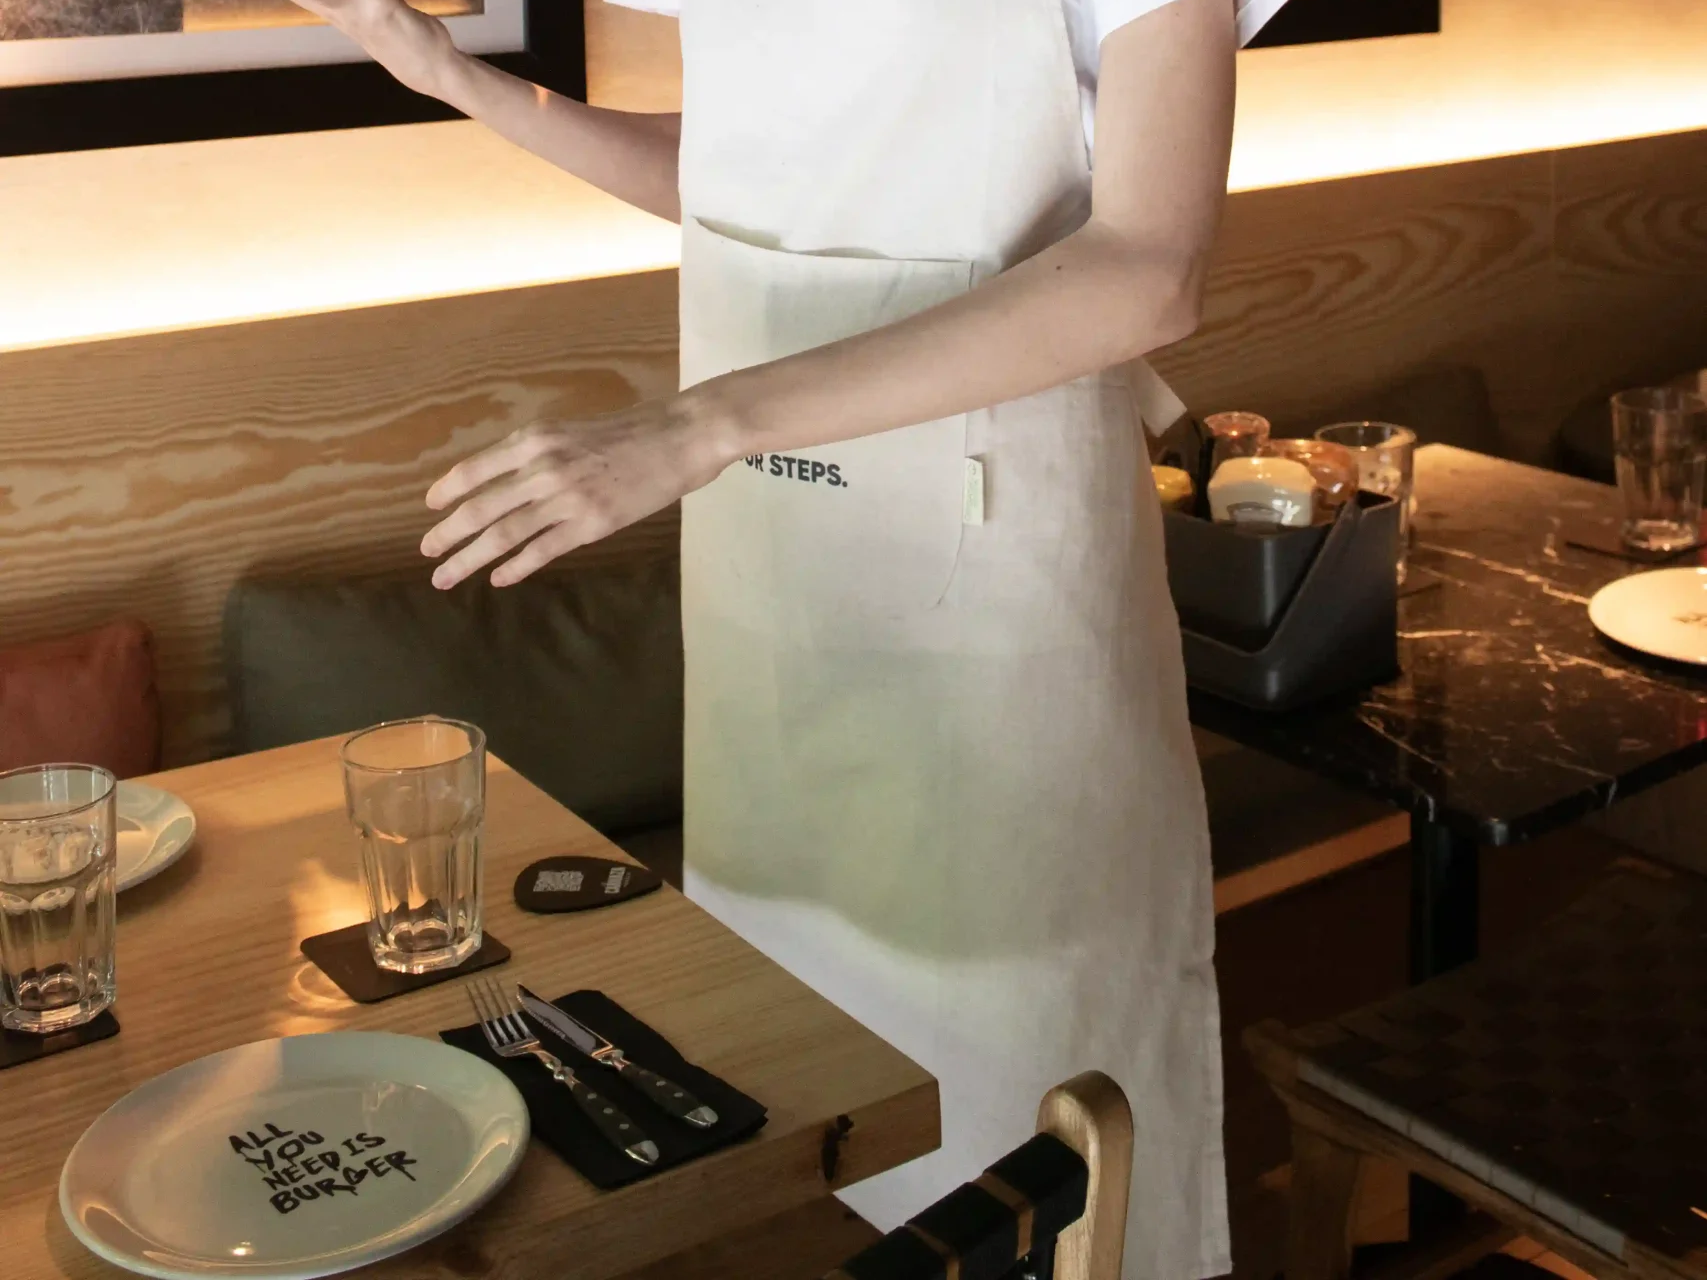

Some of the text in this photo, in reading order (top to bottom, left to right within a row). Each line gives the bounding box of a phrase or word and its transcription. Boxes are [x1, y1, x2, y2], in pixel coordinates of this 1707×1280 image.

[741, 453, 848, 488] UR STEPS.
[228, 1122, 294, 1156] ALL
[245, 1130, 325, 1171] YOU
[262, 1132, 386, 1191] NEED IS
[269, 1150, 417, 1215] BURGER
